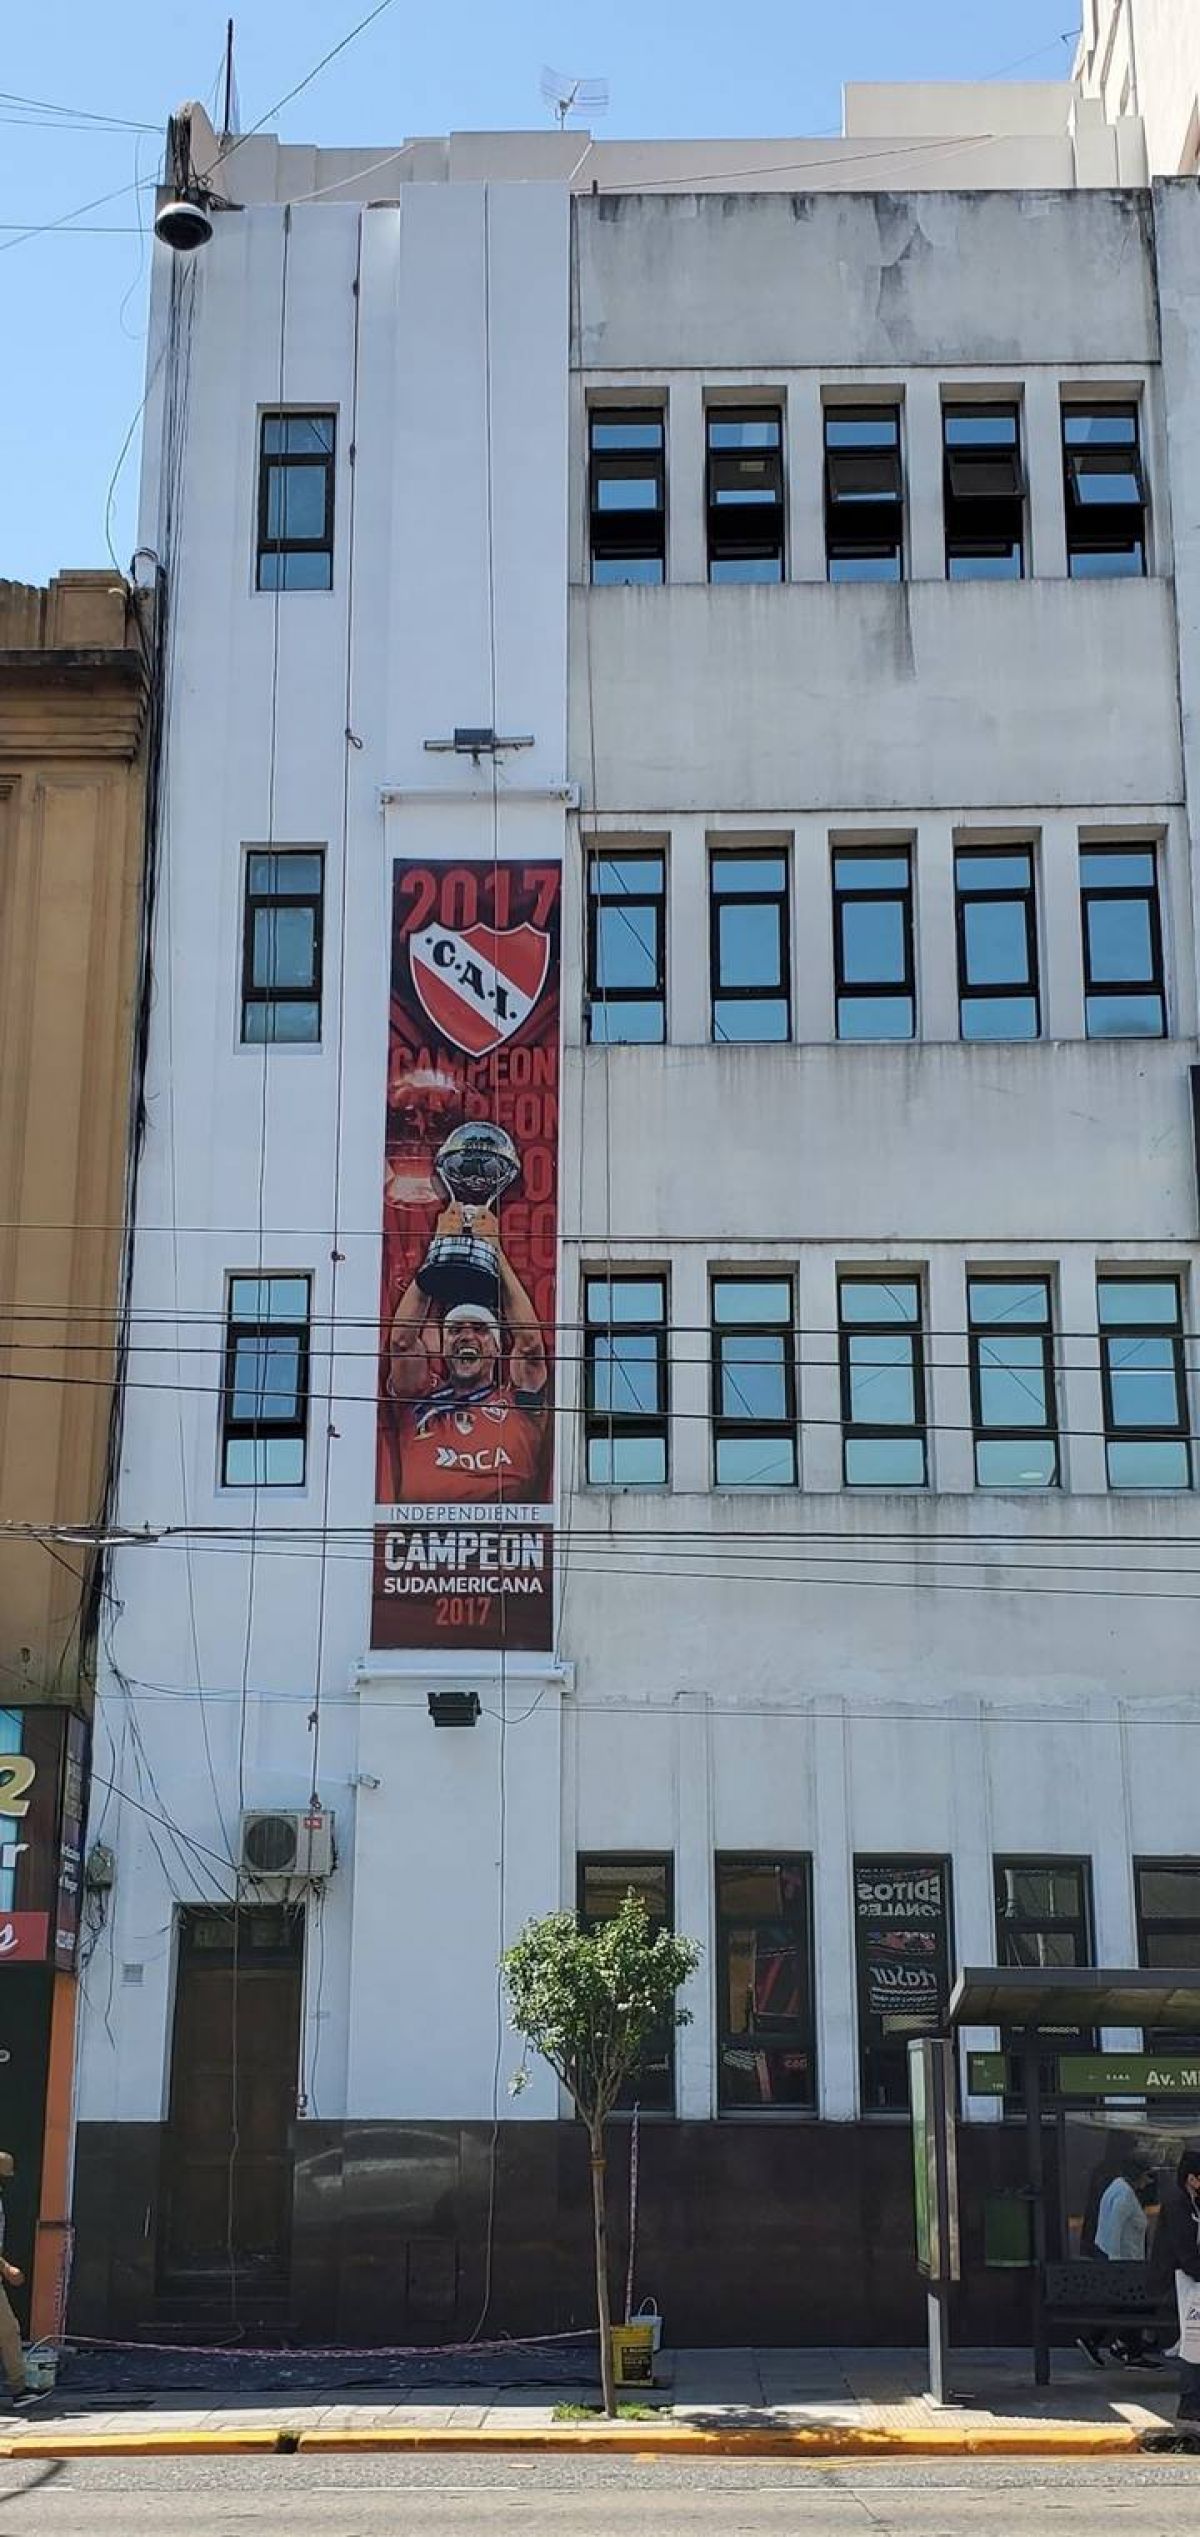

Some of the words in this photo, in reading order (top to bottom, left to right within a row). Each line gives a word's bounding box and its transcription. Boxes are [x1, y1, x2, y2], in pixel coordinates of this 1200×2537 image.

[401, 867, 560, 943] 2017
[391, 1506, 541, 1521] INDEPENDIENTE
[384, 1531, 544, 1571] CAMPEON
[383, 1576, 544, 1594] SUDAMERICANA
[435, 1597, 492, 1626] 2017
[1146, 2071, 1176, 2086] Av.
